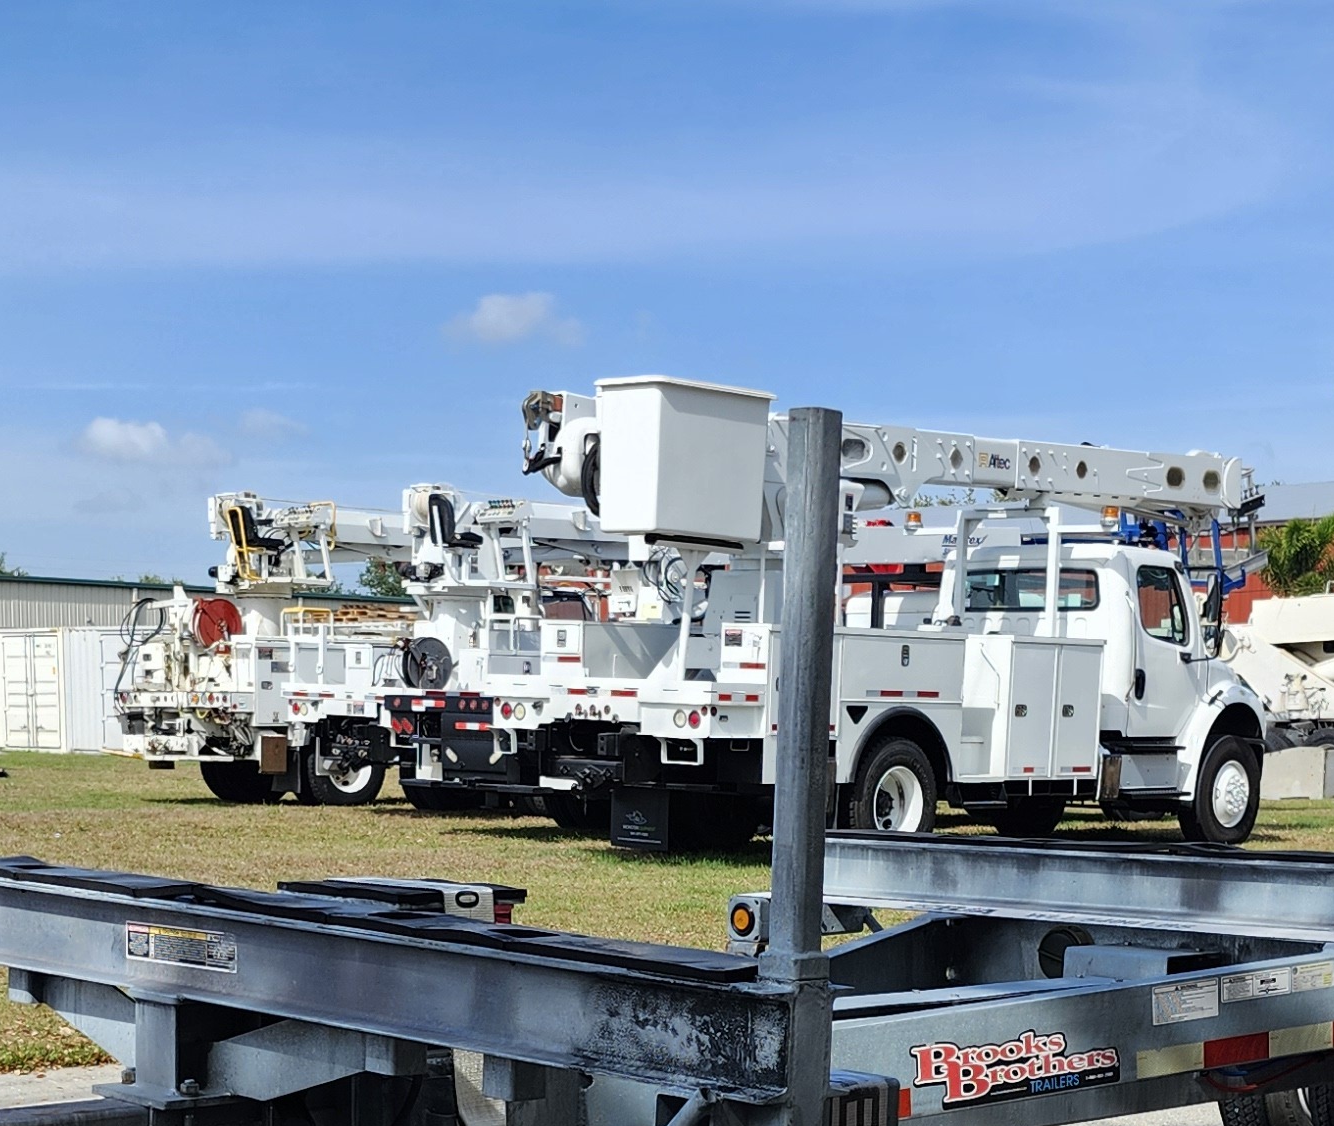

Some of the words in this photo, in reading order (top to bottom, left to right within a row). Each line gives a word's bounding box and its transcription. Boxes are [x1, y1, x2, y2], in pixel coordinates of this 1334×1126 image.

[911, 1031, 1065, 1085] Brooks
[943, 1048, 1117, 1102] Brothers
[1029, 1074, 1080, 1094] TRAILERS
